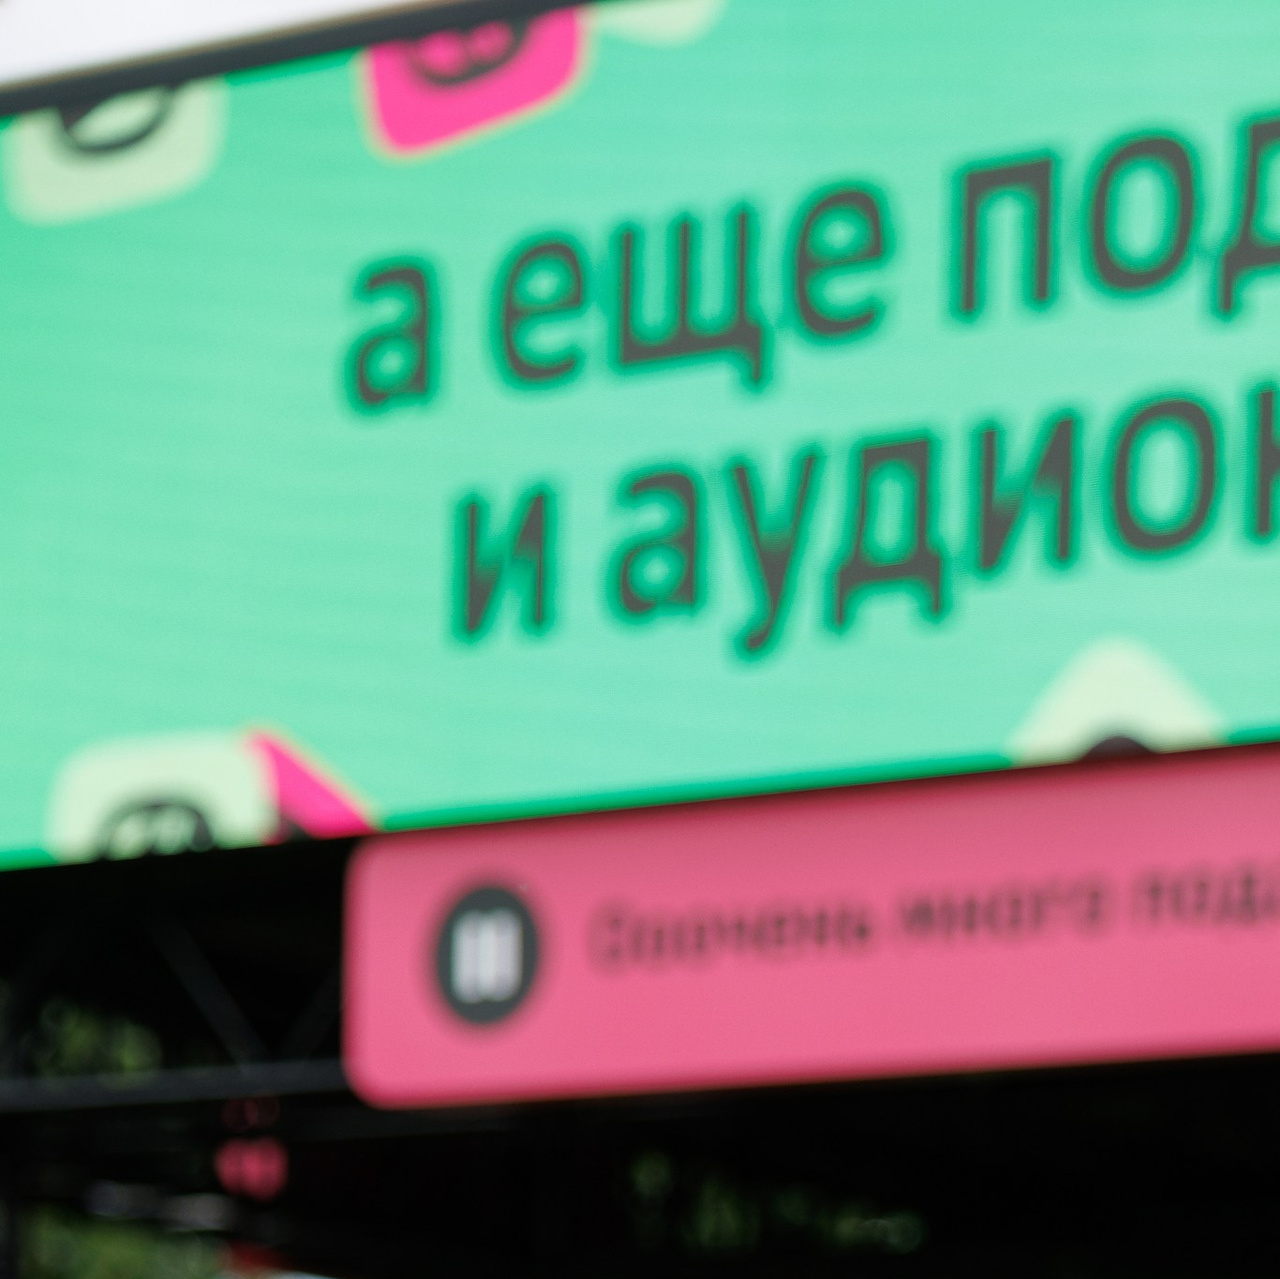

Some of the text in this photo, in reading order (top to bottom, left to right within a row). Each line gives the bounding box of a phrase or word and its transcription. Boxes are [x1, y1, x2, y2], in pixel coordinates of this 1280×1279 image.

[350, 260, 435, 410] а
[496, 186, 888, 387] еще
[460, 489, 550, 638] и
[894, 876, 1115, 946] много
